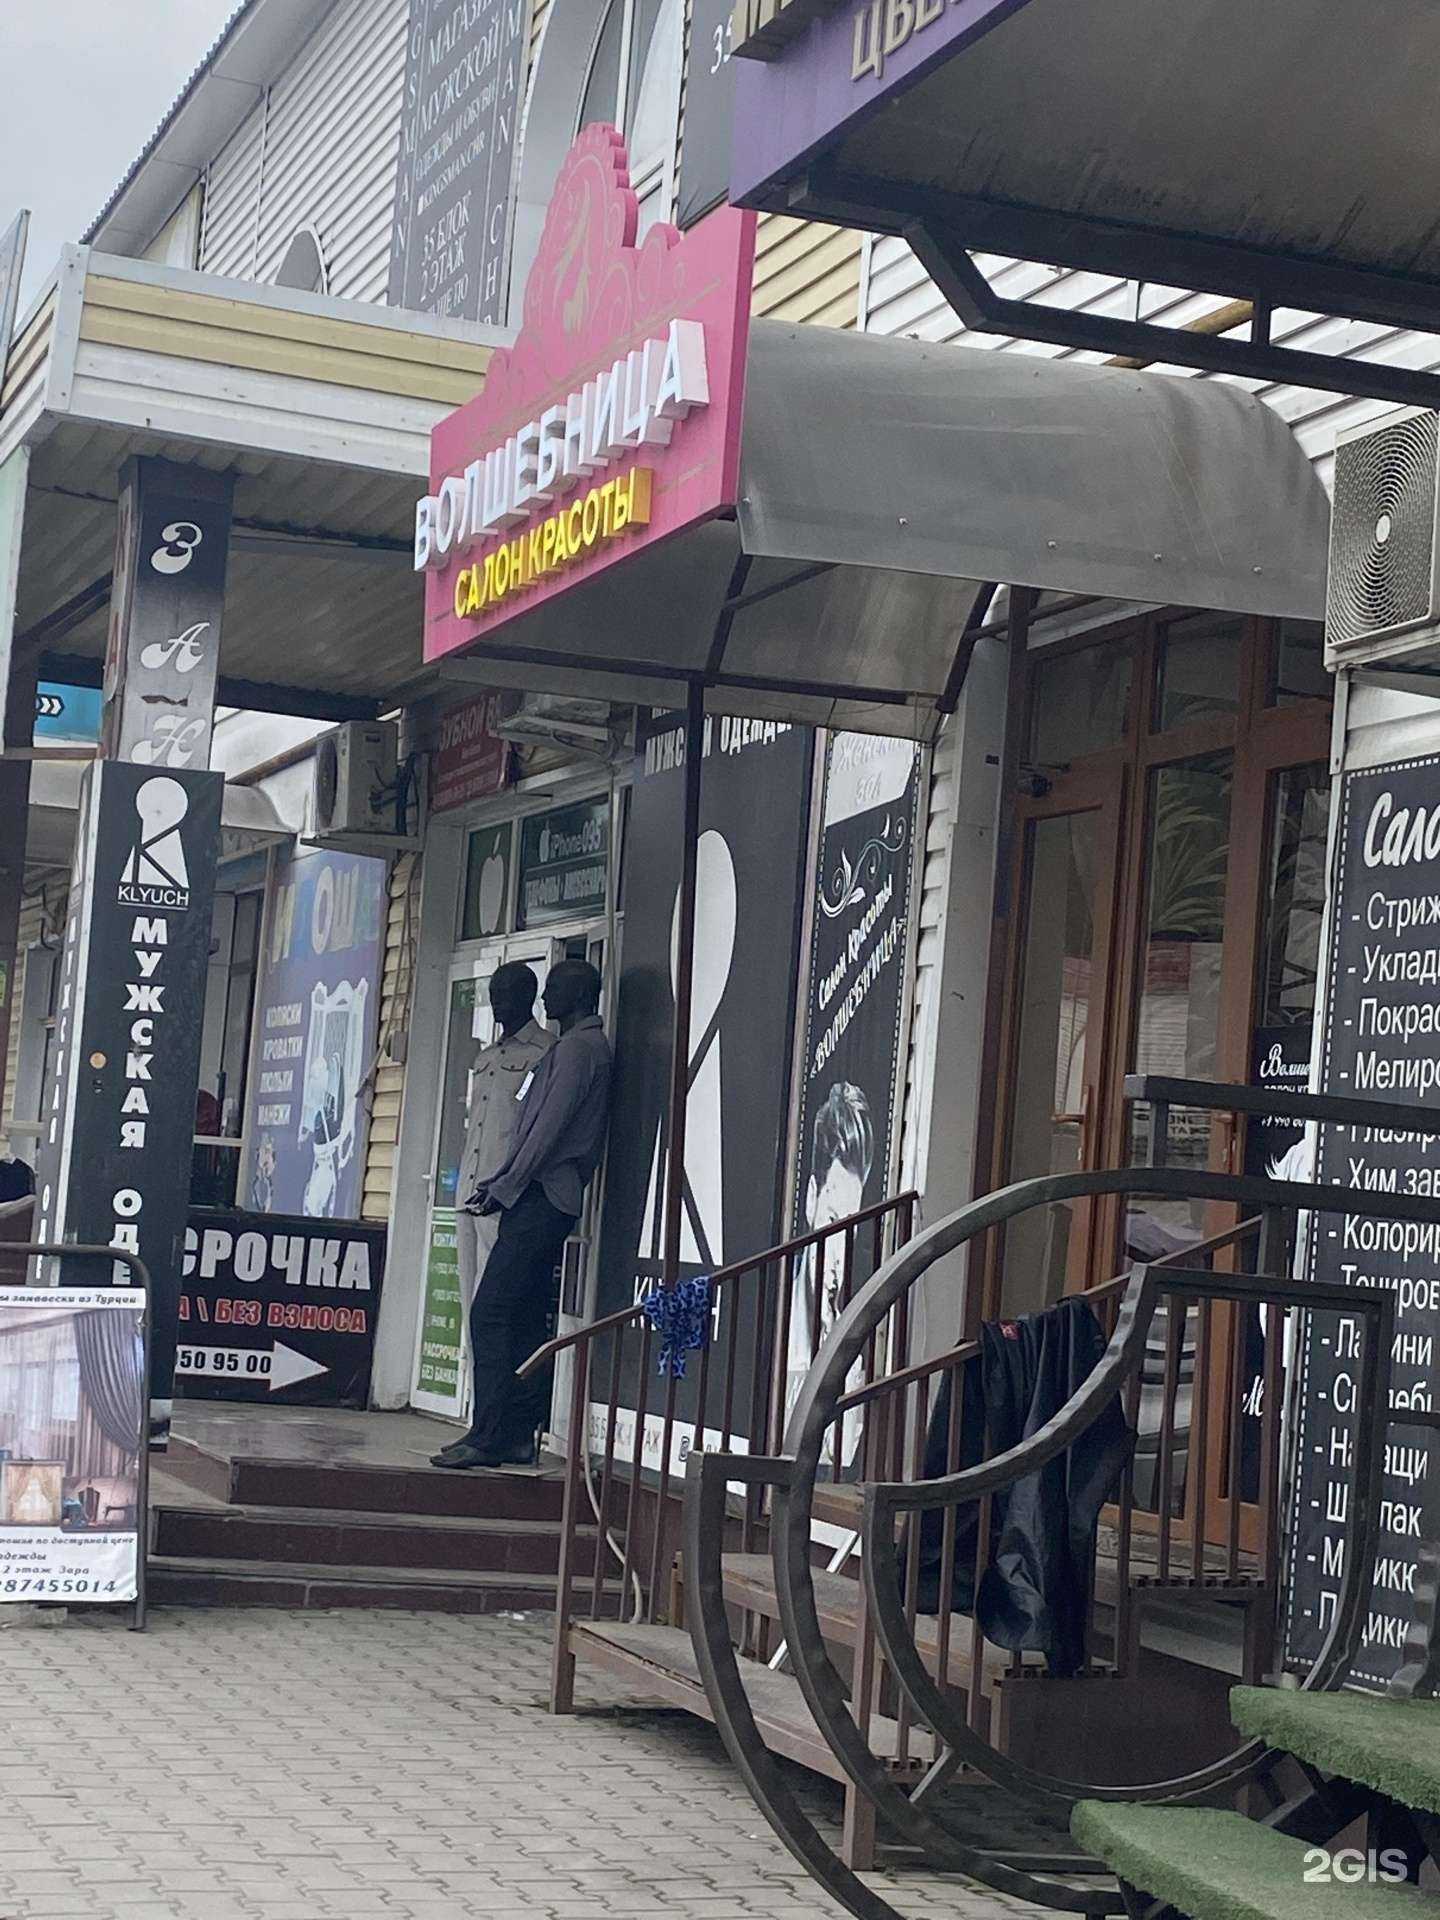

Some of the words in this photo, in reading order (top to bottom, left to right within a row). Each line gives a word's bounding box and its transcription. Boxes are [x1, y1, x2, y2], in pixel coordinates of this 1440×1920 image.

[852, 0, 960, 82] ЦВЕ
[419, 10, 499, 141] МУЖСКОЙ
[436, 190, 472, 253] БЛОК
[429, 231, 467, 294] ЭТАЖ
[414, 319, 706, 573] ВОЛШЕБНИЦА
[454, 537, 530, 619] САЛОН
[529, 467, 653, 575] КРАСОТЫ
[117, 886, 189, 906] KLYUCH
[818, 951, 848, 1011] Салон
[1363, 945, 1440, 985] Уклад
[119, 916, 169, 1149] МУЖСКАЯ
[214, 1298, 262, 1326] БЕЗ
[267, 1302, 366, 1334] ВЗНОСА
[176, 1350, 206, 1370] 50
[213, 1352, 240, 1372] 95
[246, 1354, 272, 1374] 00
[0, 1579, 117, 1593] 87455014
